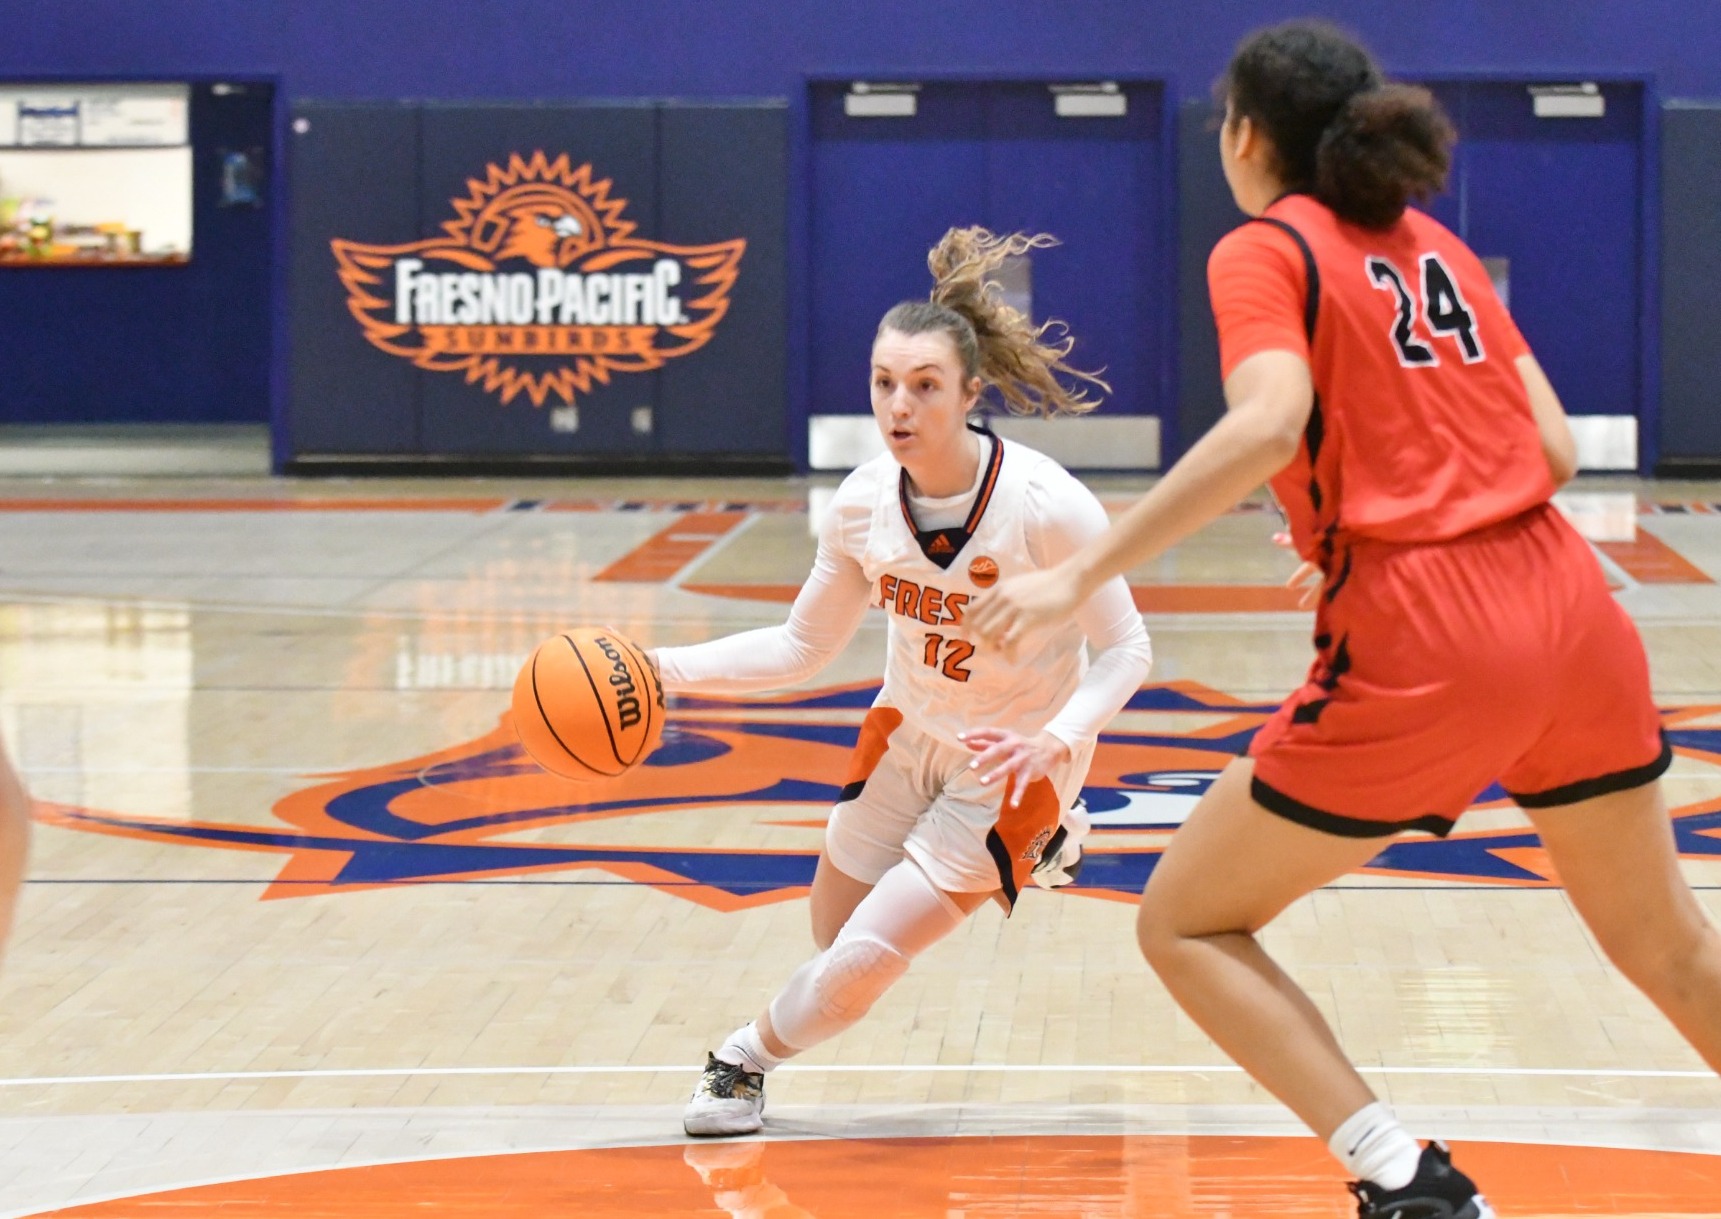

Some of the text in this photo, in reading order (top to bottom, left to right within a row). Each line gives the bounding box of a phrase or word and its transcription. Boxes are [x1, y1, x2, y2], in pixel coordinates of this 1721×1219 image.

[395, 258, 681, 325] FRESNO PACIFIC
[1364, 251, 1487, 368] 24
[446, 330, 632, 351] SUNBIRDS
[879, 573, 977, 627] FRES
[594, 637, 642, 732] Wilson
[924, 633, 975, 682] 12
